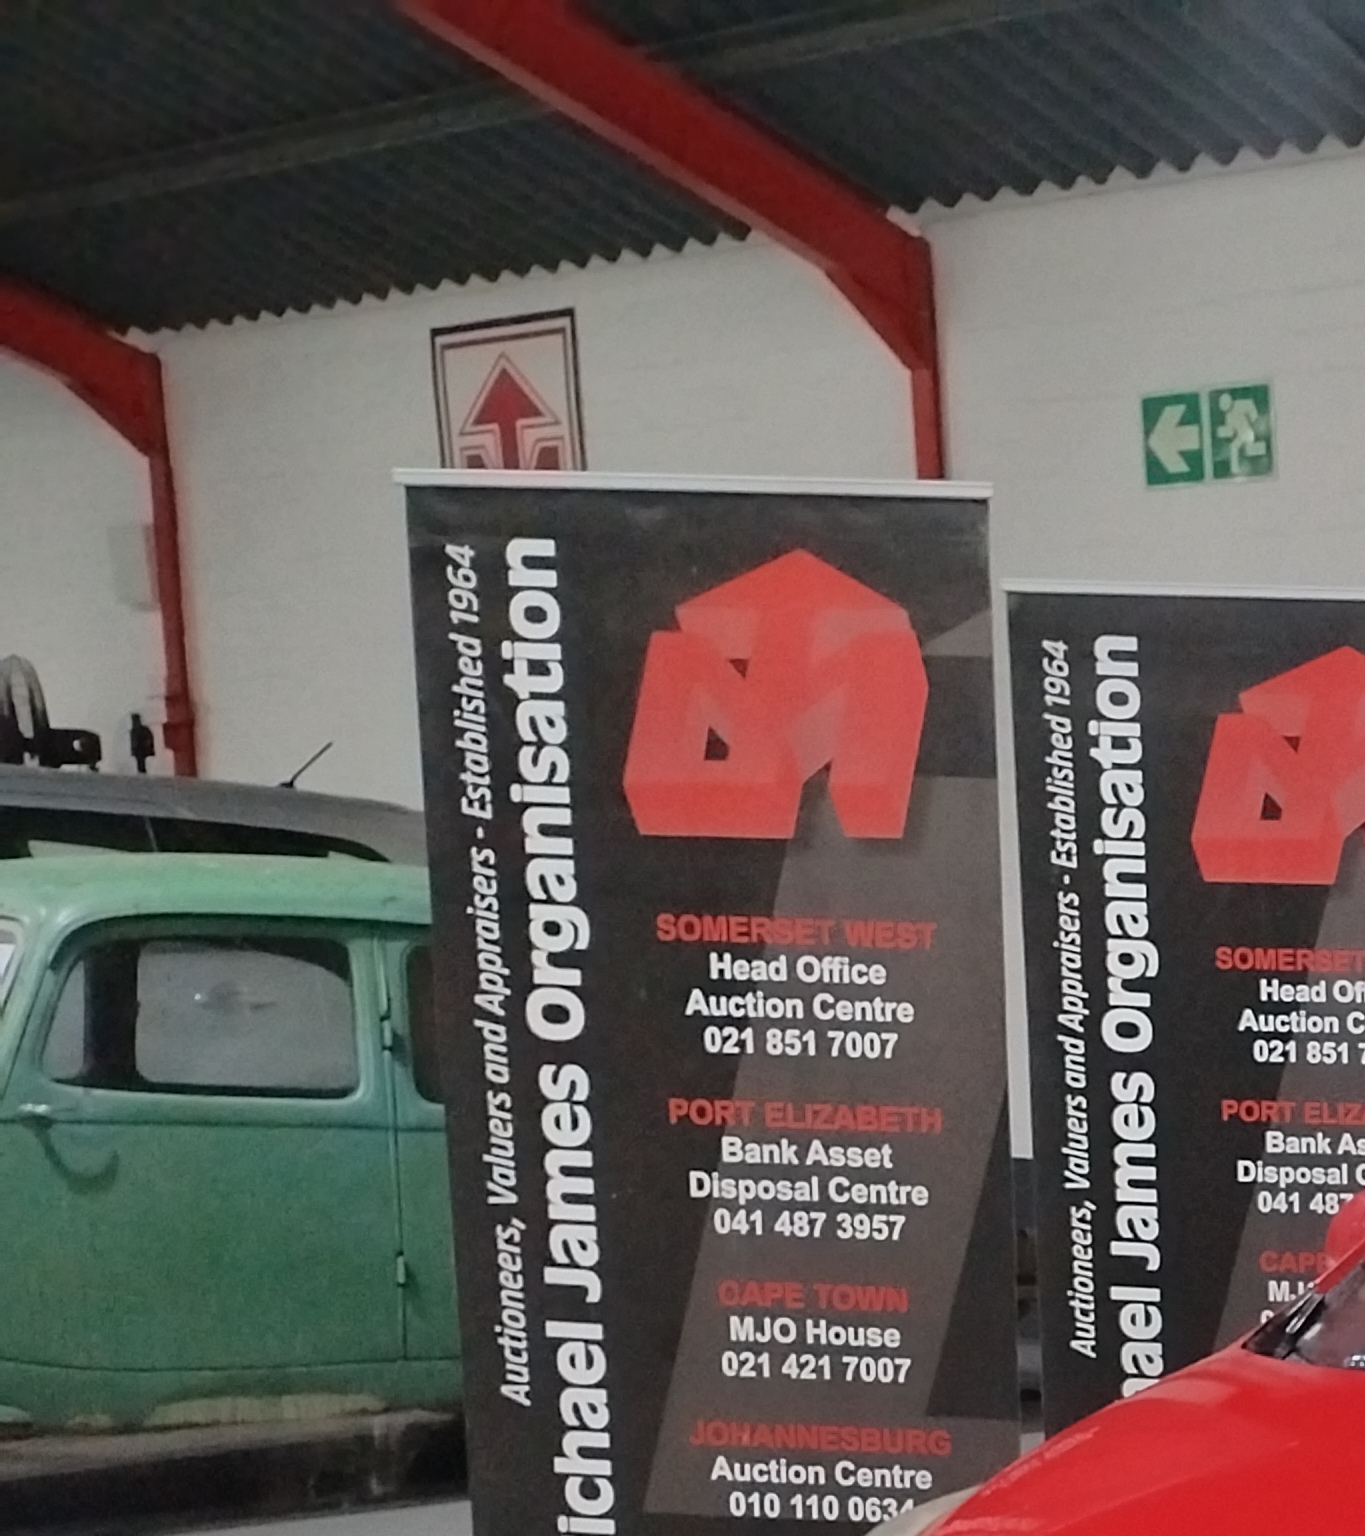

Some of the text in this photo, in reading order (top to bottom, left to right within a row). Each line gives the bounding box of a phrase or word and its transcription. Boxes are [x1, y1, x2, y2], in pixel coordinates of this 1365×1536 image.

[501, 537, 591, 1042] Organisation
[1088, 634, 1159, 1053] Organisation
[657, 914, 934, 949] SOMERSET WEST
[444, 543, 531, 1406] Auctioneers, Valuers and Appraisers - Established 1964
[709, 951, 887, 985] Head Office
[1215, 946, 1365, 972] SOMERSET
[685, 988, 915, 1023] Auction Centre
[1041, 640, 1097, 1359] Auctioneers, Valuers and Appraisers - Established 1964
[1259, 978, 1327, 1003] Head
[1237, 1008, 1340, 1034] Auction
[703, 1025, 899, 1059] 021 851 7007
[1253, 1039, 1297, 1064] 021
[1306, 1040, 1349, 1065] 851
[668, 1097, 942, 1133] PORT ELIZABETH
[1221, 1099, 1295, 1123] PORT
[721, 1135, 894, 1169] Bank Asset
[1265, 1130, 1332, 1155] Bank
[538, 1063, 602, 1303] James
[689, 1170, 929, 1206] Disposal Centre
[1109, 1071, 1161, 1272] James
[1237, 1159, 1349, 1189] Disposal
[1257, 1190, 1300, 1214] 041
[713, 1207, 906, 1241] 041 487 3957
[717, 1280, 909, 1311] CAPE TOWN
[729, 1315, 901, 1348] MJO House
[721, 1350, 912, 1384] 021 421 7007
[691, 1420, 951, 1456] JOHANNESBURG
[710, 1455, 933, 1490] Auction Centre
[729, 1491, 781, 1519] 010
[790, 1493, 840, 1521] 110
